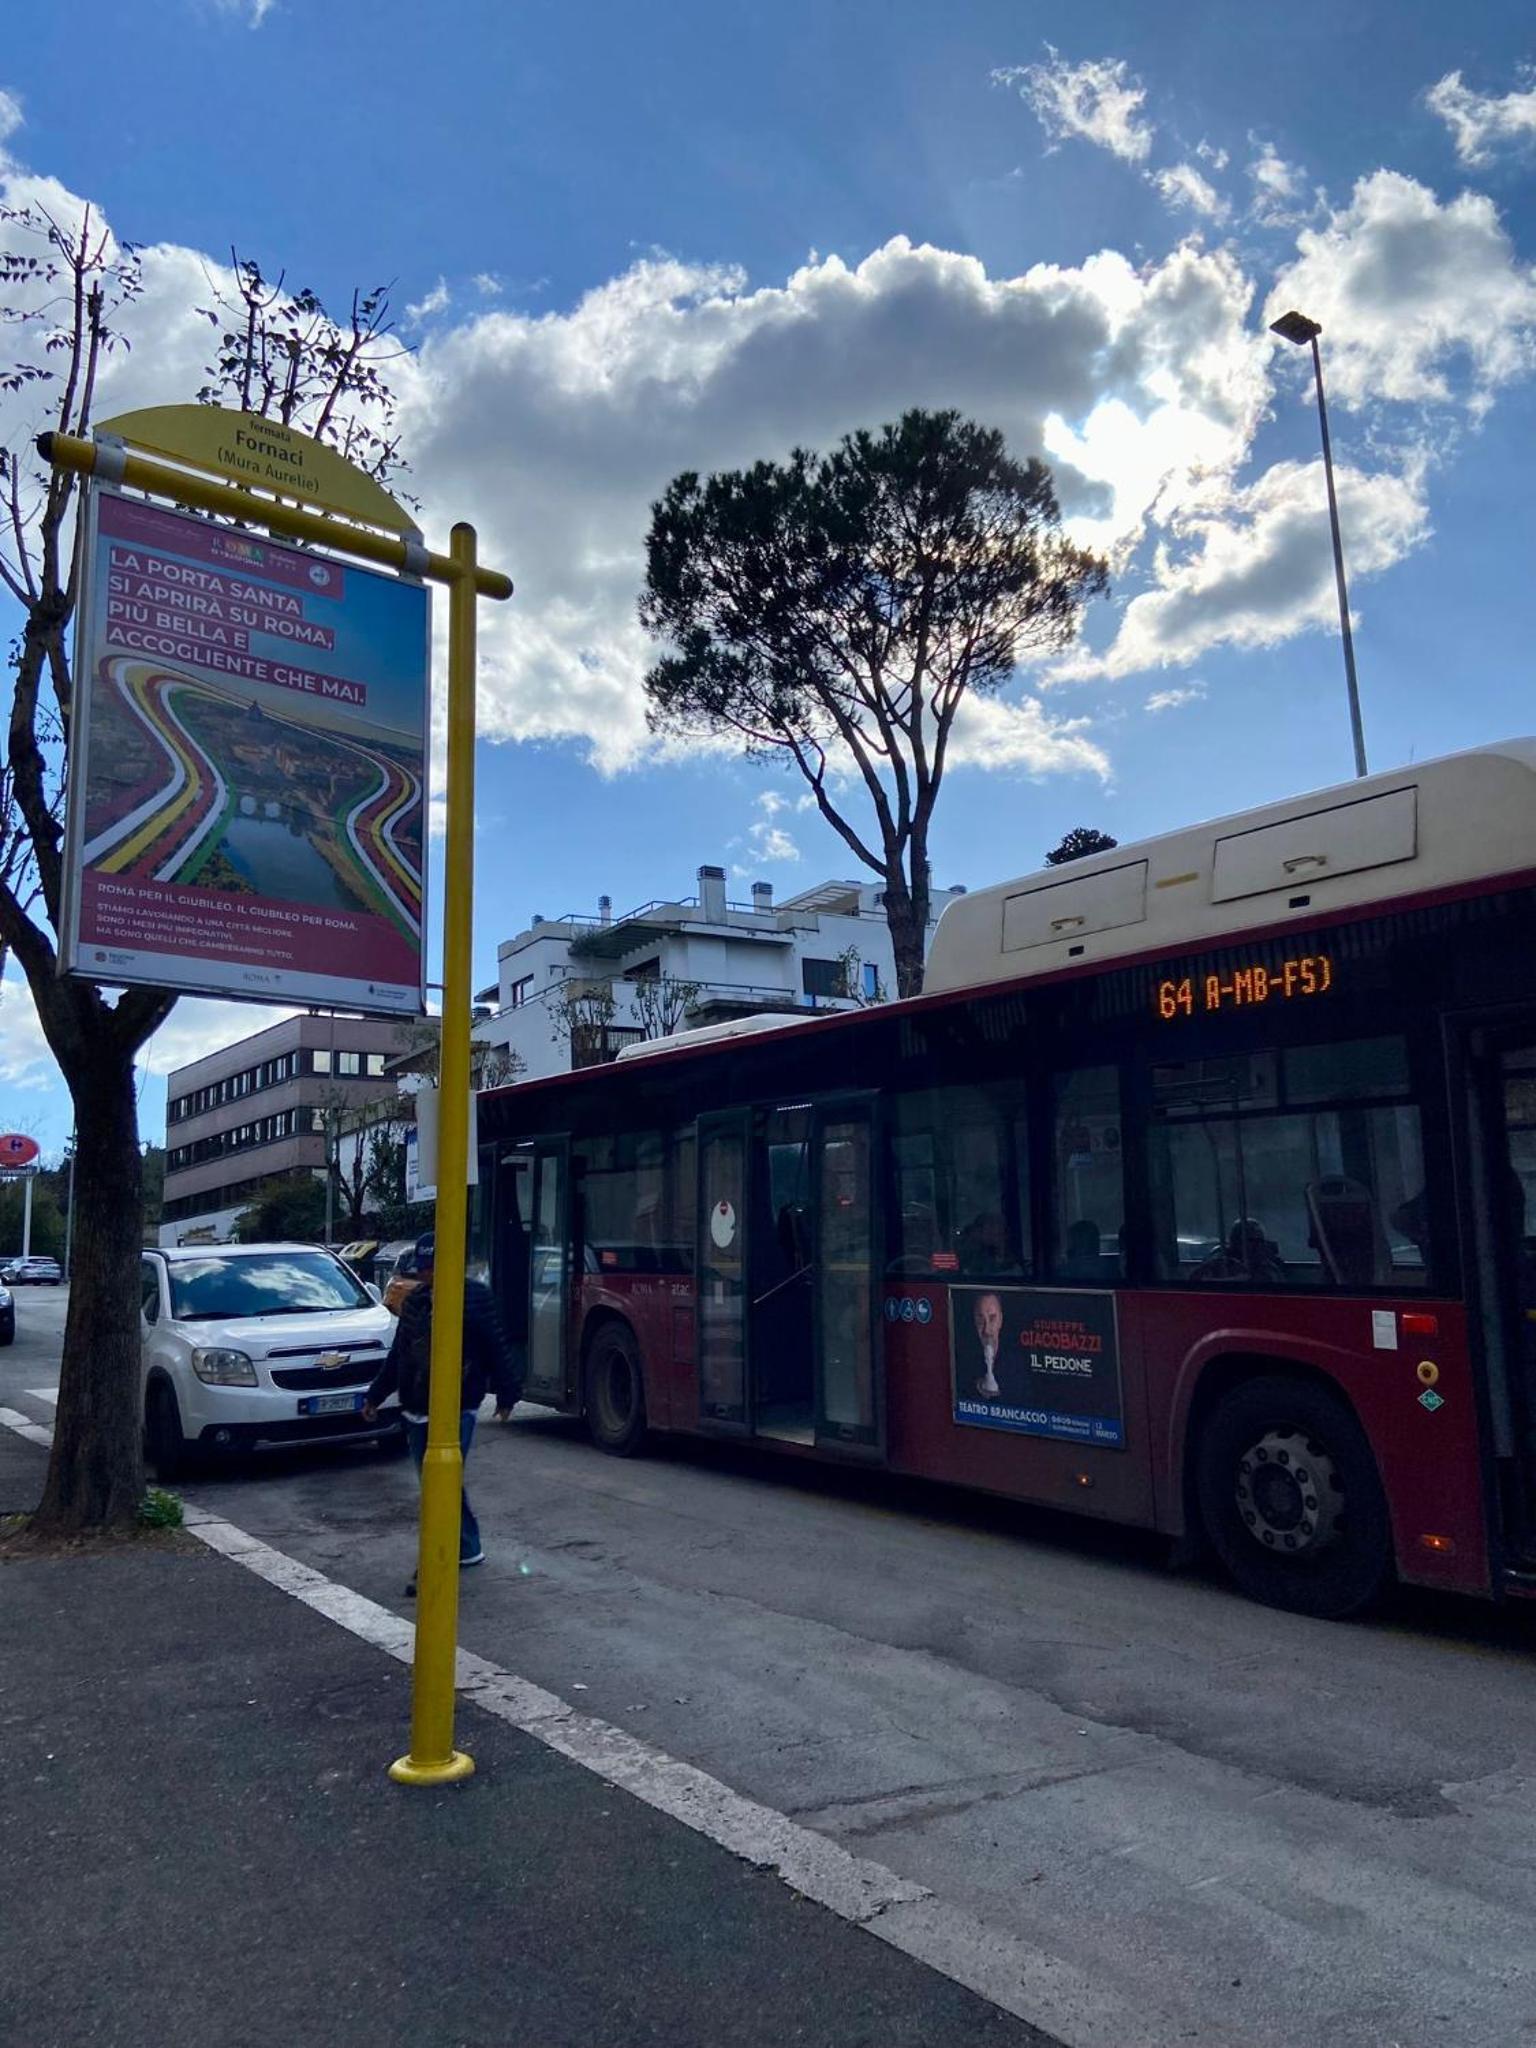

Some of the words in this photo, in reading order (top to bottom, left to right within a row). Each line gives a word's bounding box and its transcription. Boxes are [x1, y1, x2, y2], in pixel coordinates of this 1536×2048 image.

[235, 429, 304, 466] Fornaci
[250, 419, 291, 443] fermata
[217, 446, 261, 474] (Mura
[264, 461, 320, 493] Aurelie)
[110, 549, 139, 572] LA
[147, 561, 224, 593] PORTA
[229, 581, 301, 615] SANTA
[109, 575, 132, 593] SI
[136, 581, 224, 617] APRIRÀ
[229, 606, 258, 627] SU
[264, 616, 334, 650] ROMA,
[109, 601, 148, 623] PIÙ
[156, 611, 229, 645] BELLA
[234, 632, 248, 648] E
[108, 627, 267, 680] ACCOGLIENTE
[273, 666, 316, 693] CHE
[321, 679, 366, 704] MAI.
[96, 913, 125, 925] SONO
[97, 902, 134, 915] STIAMO
[98, 883, 136, 897] ROMA
[138, 889, 162, 902] PER
[165, 893, 175, 904] IL
[237, 904, 247, 915] IL
[249, 906, 300, 922] GIUBILEO
[302, 915, 323, 927] PER
[325, 918, 359, 931] ROMA.
[1159, 977, 1193, 1019] 64
[1205, 955, 1331, 1010] A-MB-FS)
[1019, 1330, 1104, 1353] GIACOBAZZI
[1030, 1354, 1042, 1368] IL
[1044, 1355, 1093, 1374] PEDONE
[958, 1401, 988, 1416] TEATRO
[990, 1405, 1048, 1425] BRANCACCIO
